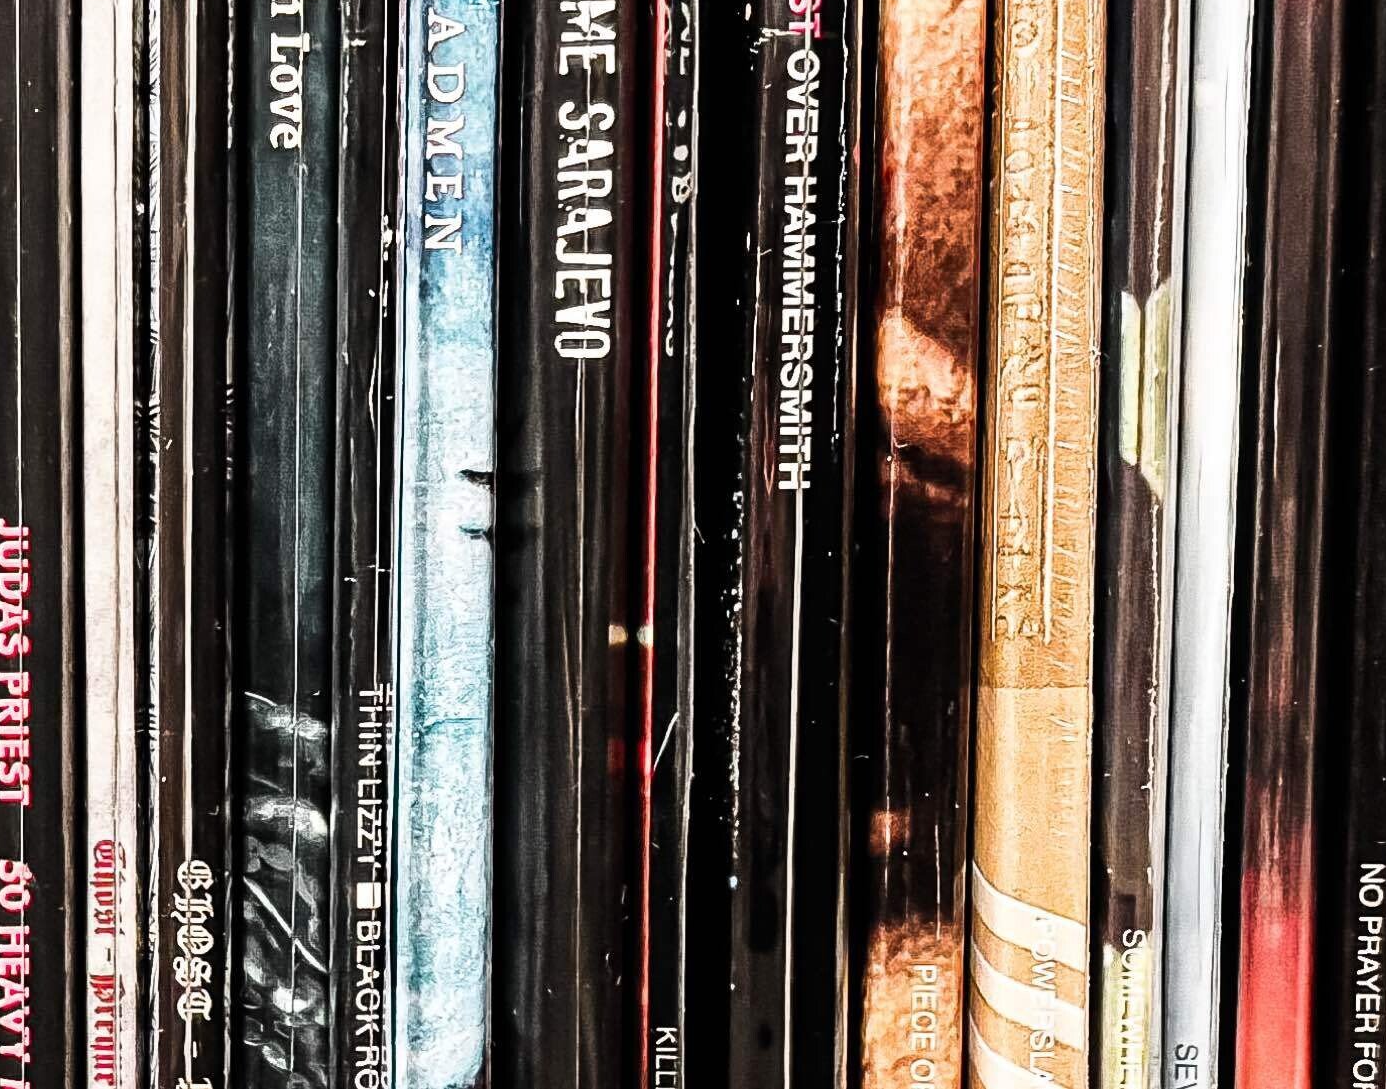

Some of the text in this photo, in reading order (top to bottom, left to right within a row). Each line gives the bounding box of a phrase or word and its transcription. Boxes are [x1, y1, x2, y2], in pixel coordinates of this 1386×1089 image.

[269, 32, 313, 150] Love
[559, 0, 616, 76] ME
[786, 50, 818, 162] OVER
[555, 102, 614, 358] SARAJEVO
[779, 176, 817, 489] HAMMERSMITH
[355, 684, 384, 1035] THIN LIZZY BLACK
[1359, 863, 1386, 908] NO
[911, 964, 936, 1047] PIECE
[1355, 916, 1384, 1033] PRAYER
[656, 1027, 678, 1089] KILL
